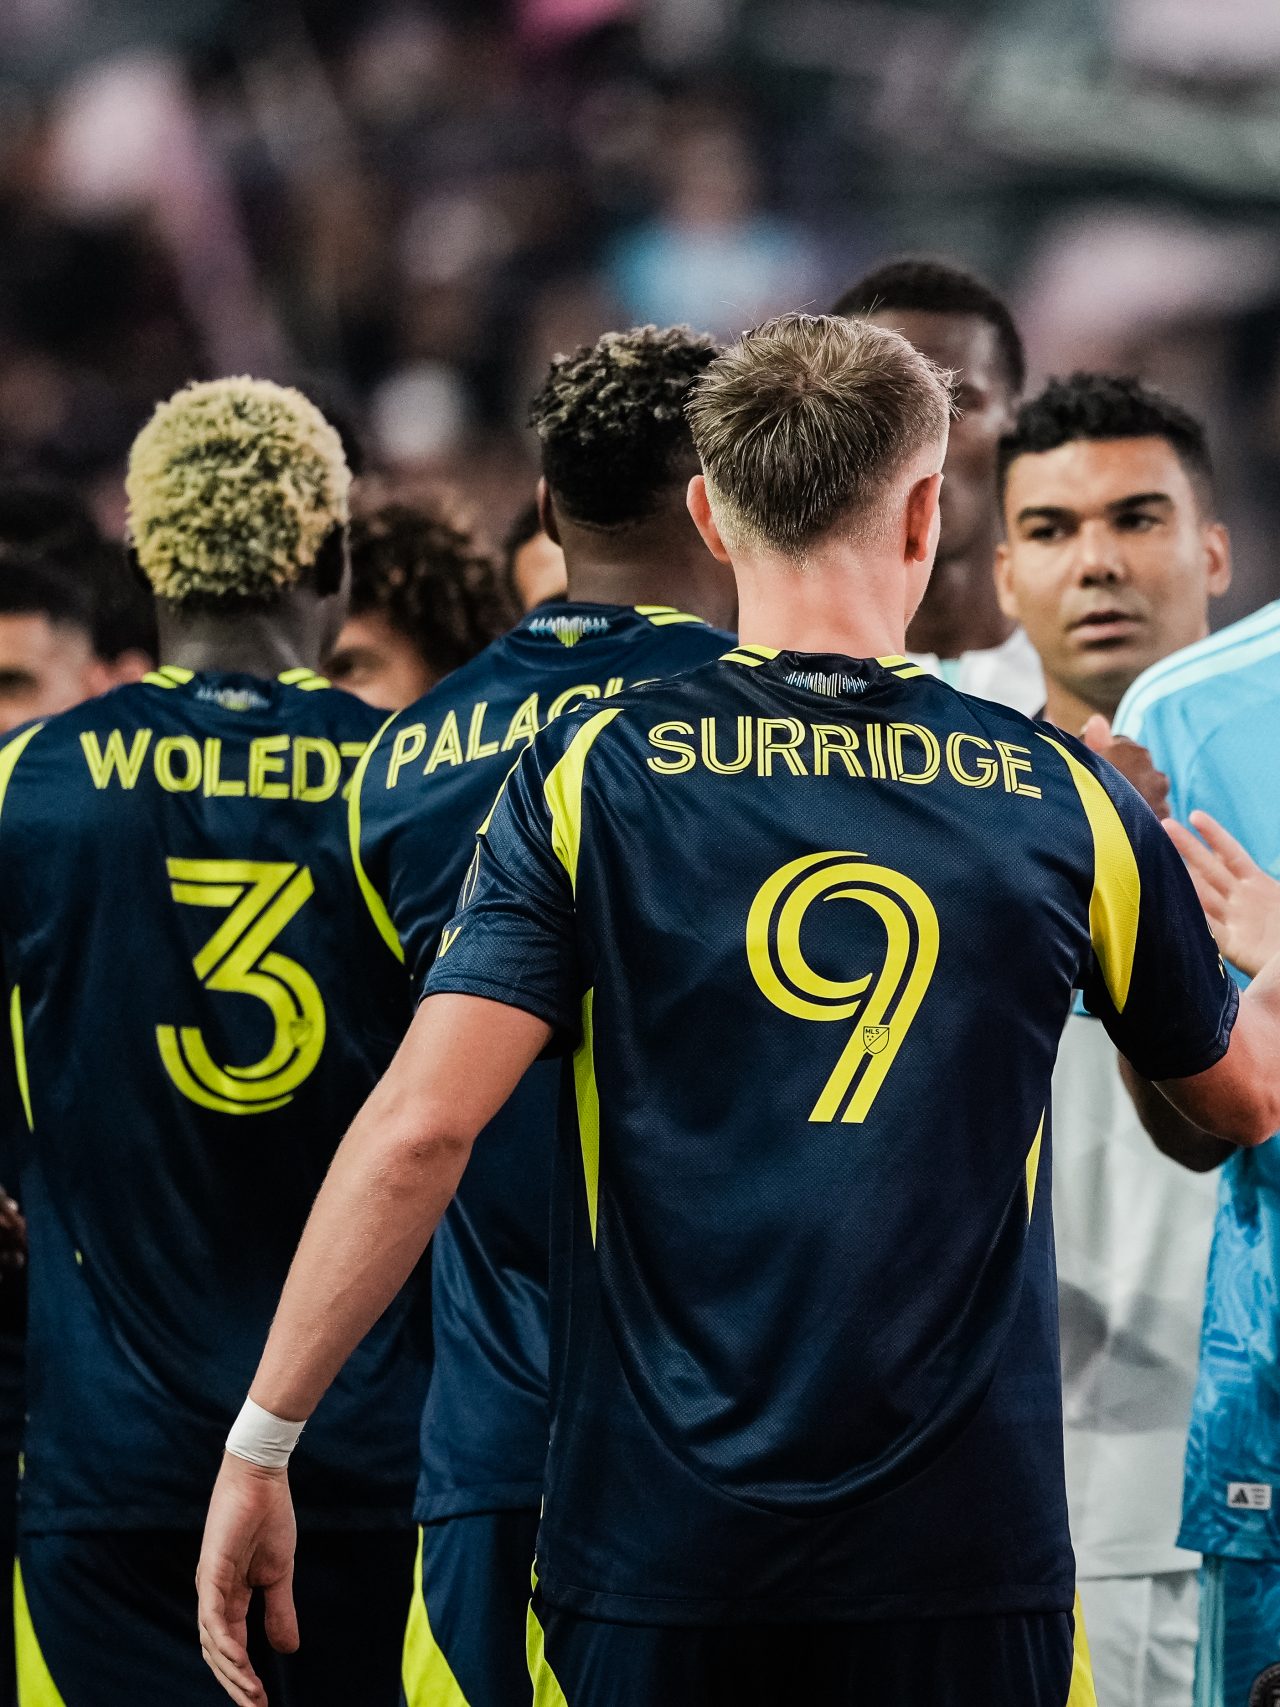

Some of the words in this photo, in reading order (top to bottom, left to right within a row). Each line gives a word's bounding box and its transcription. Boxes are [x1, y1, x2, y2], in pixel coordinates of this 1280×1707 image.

[647, 716, 1042, 799] SURRIDGE
[156, 857, 326, 1116] 3
[746, 850, 940, 1123] 9
